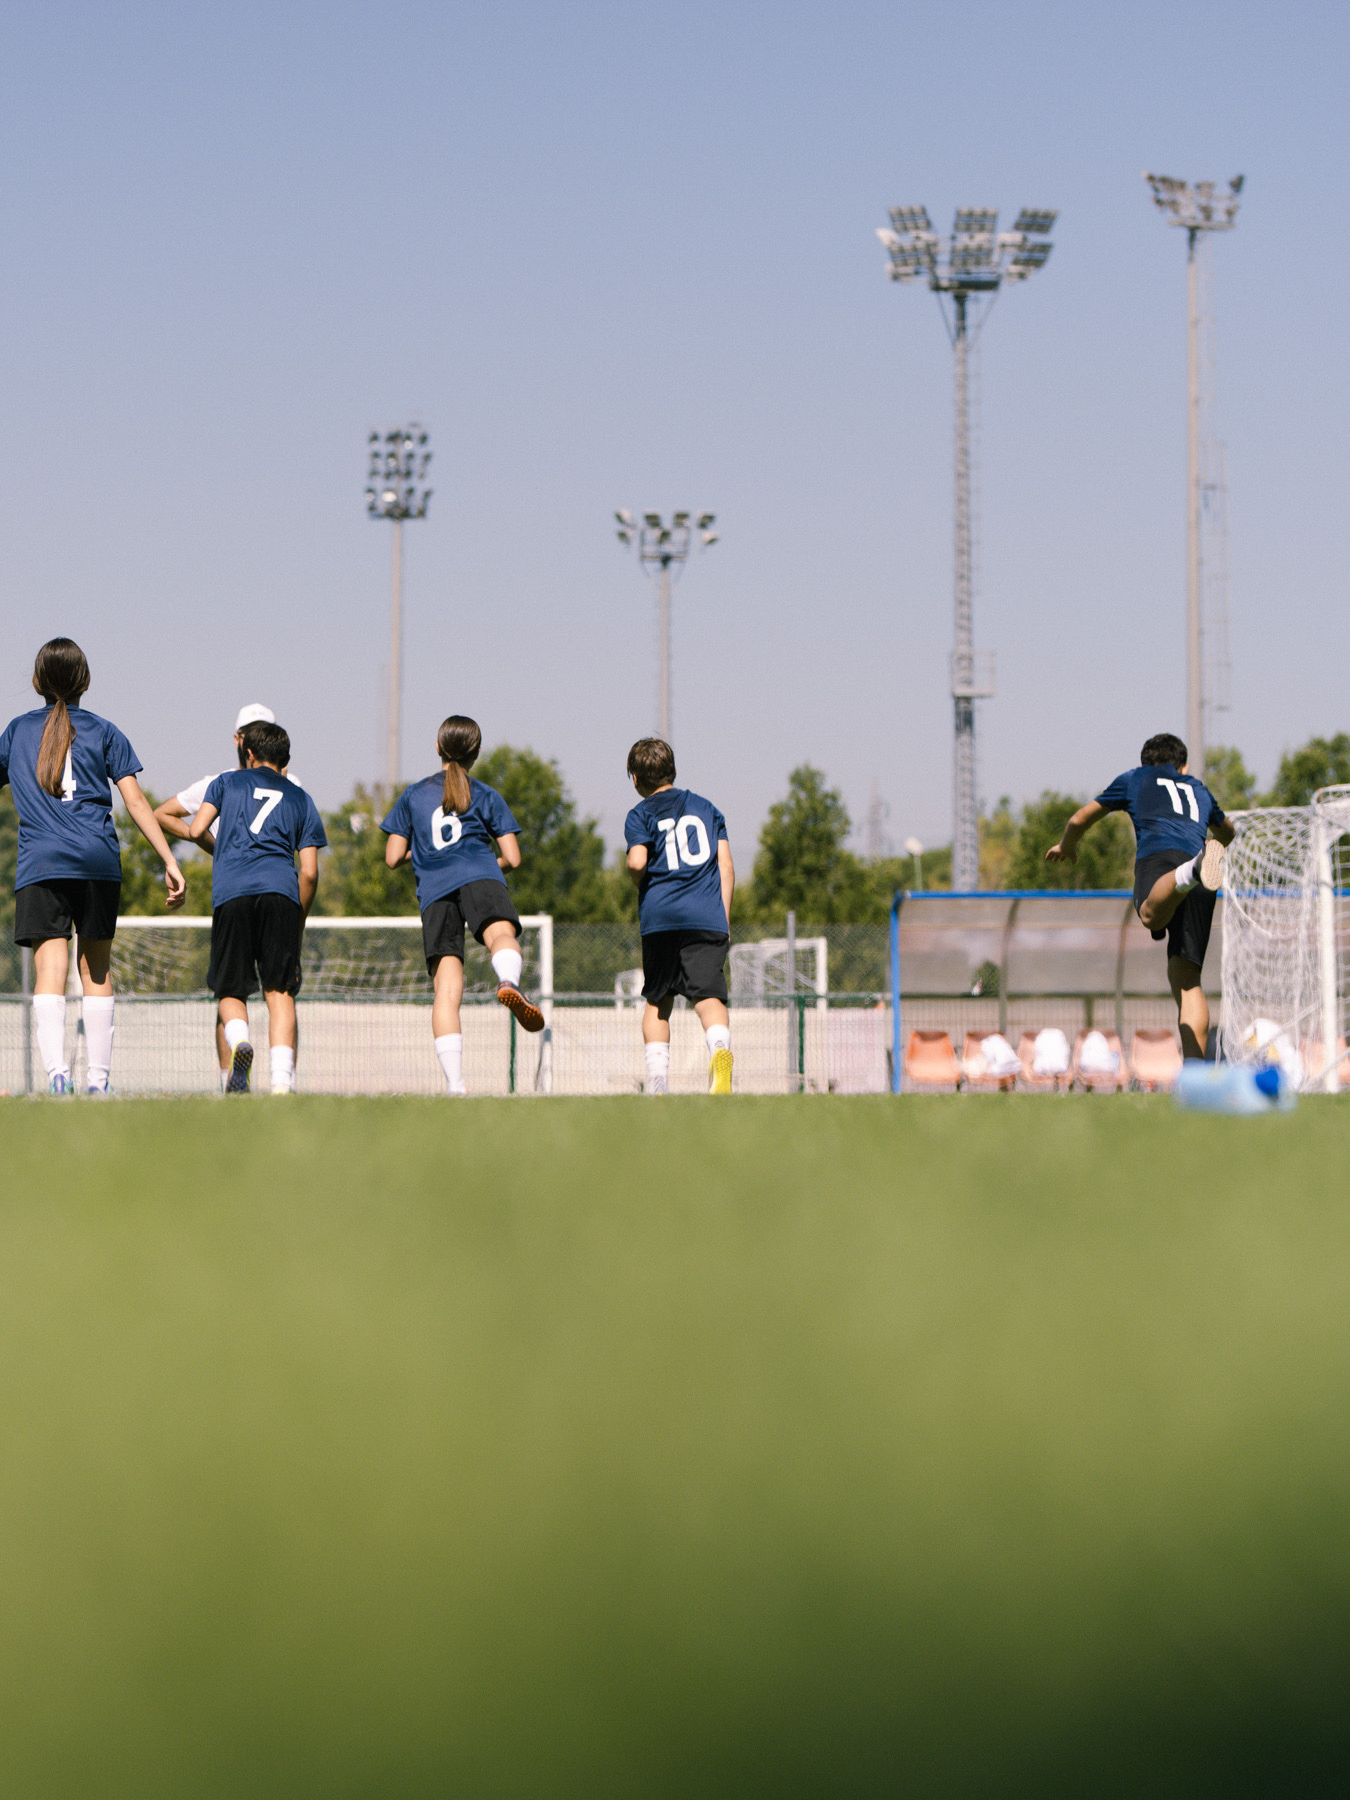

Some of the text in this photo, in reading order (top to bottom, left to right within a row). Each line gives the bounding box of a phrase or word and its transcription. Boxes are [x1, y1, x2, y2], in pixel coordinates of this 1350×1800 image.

[249, 787, 284, 835] 7
[1156, 777, 1200, 824] 11
[431, 805, 463, 851] 6
[657, 814, 711, 871] 10
